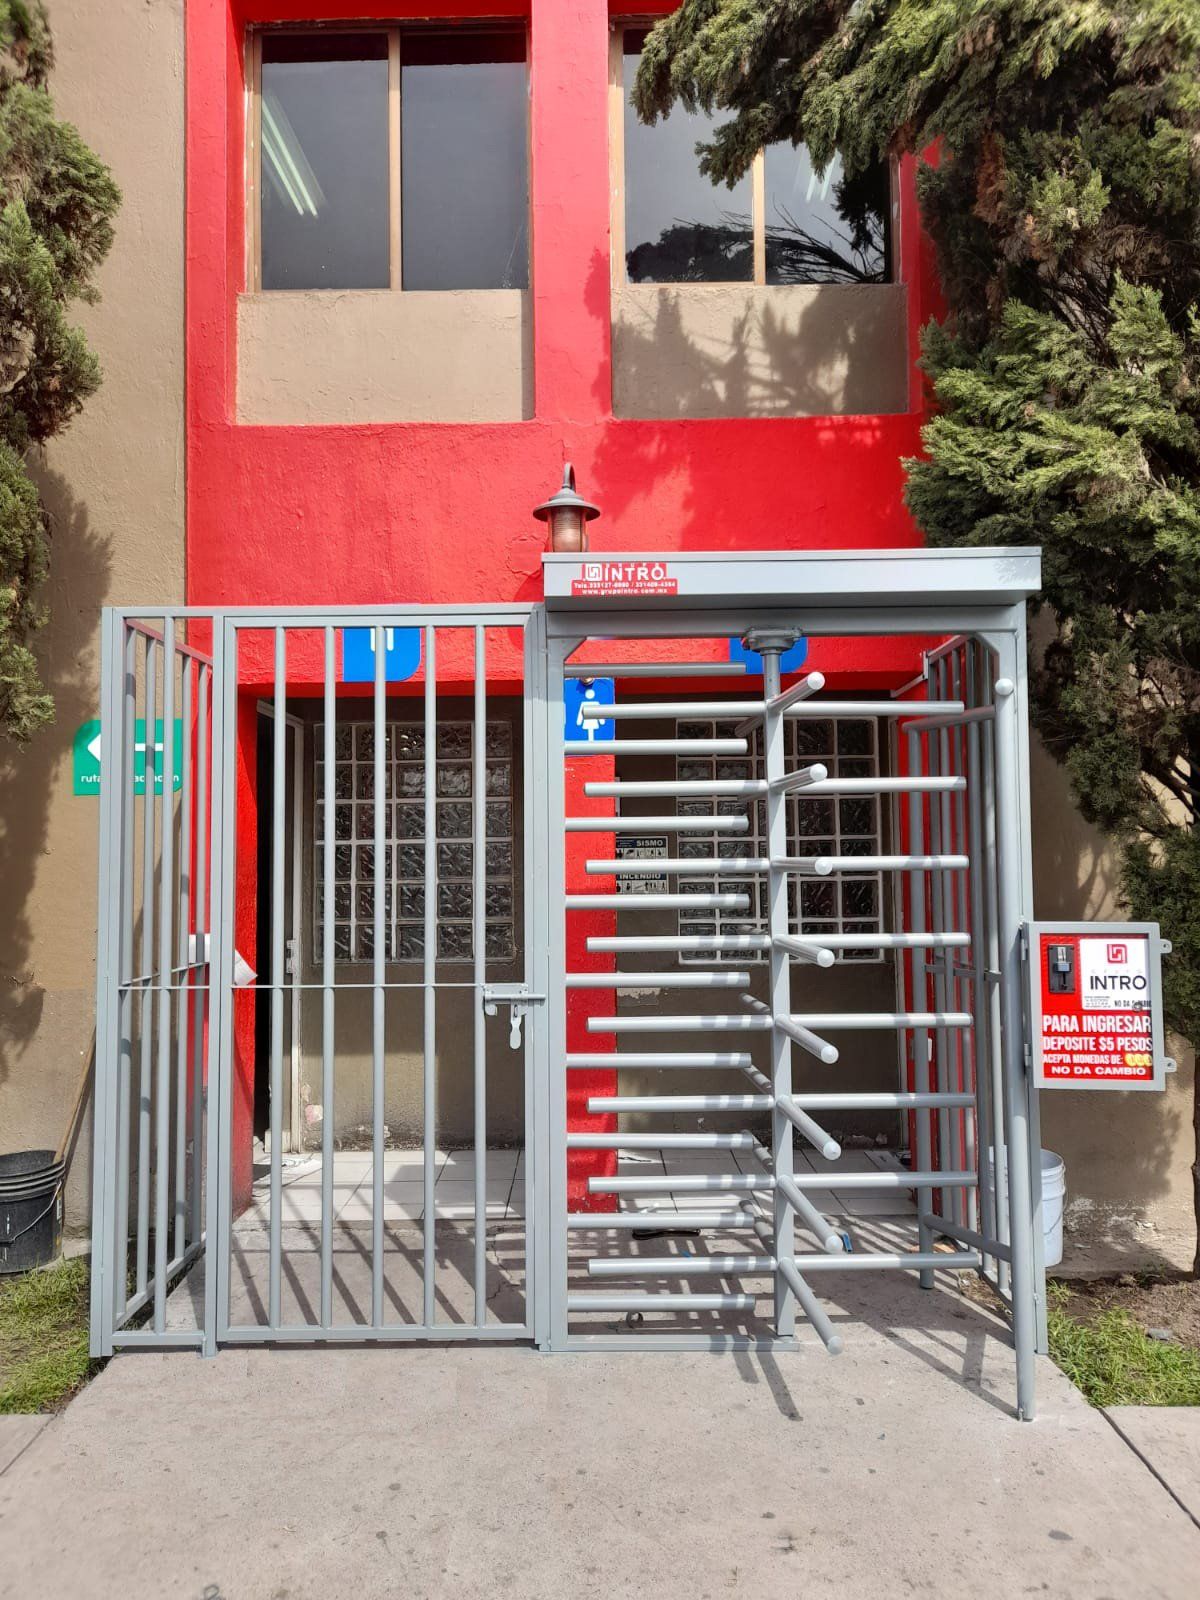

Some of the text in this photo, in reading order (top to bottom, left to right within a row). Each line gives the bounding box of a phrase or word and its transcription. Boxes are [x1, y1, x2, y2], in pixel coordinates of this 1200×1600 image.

[604, 567, 664, 581] INTRO
[636, 839, 663, 847] SISMO
[1090, 975, 1147, 990] INTRO
[1114, 1000, 1122, 1008] NO
[1043, 1014, 1152, 1033] PARA INGRESAR
[1043, 1036, 1153, 1052] DEPOSITE $5 PESOS
[1042, 1053, 1072, 1064] ACEPTA
[1072, 1054, 1110, 1065] MONEDAS
[1051, 1066, 1146, 1076] NO DA CAMBIO
